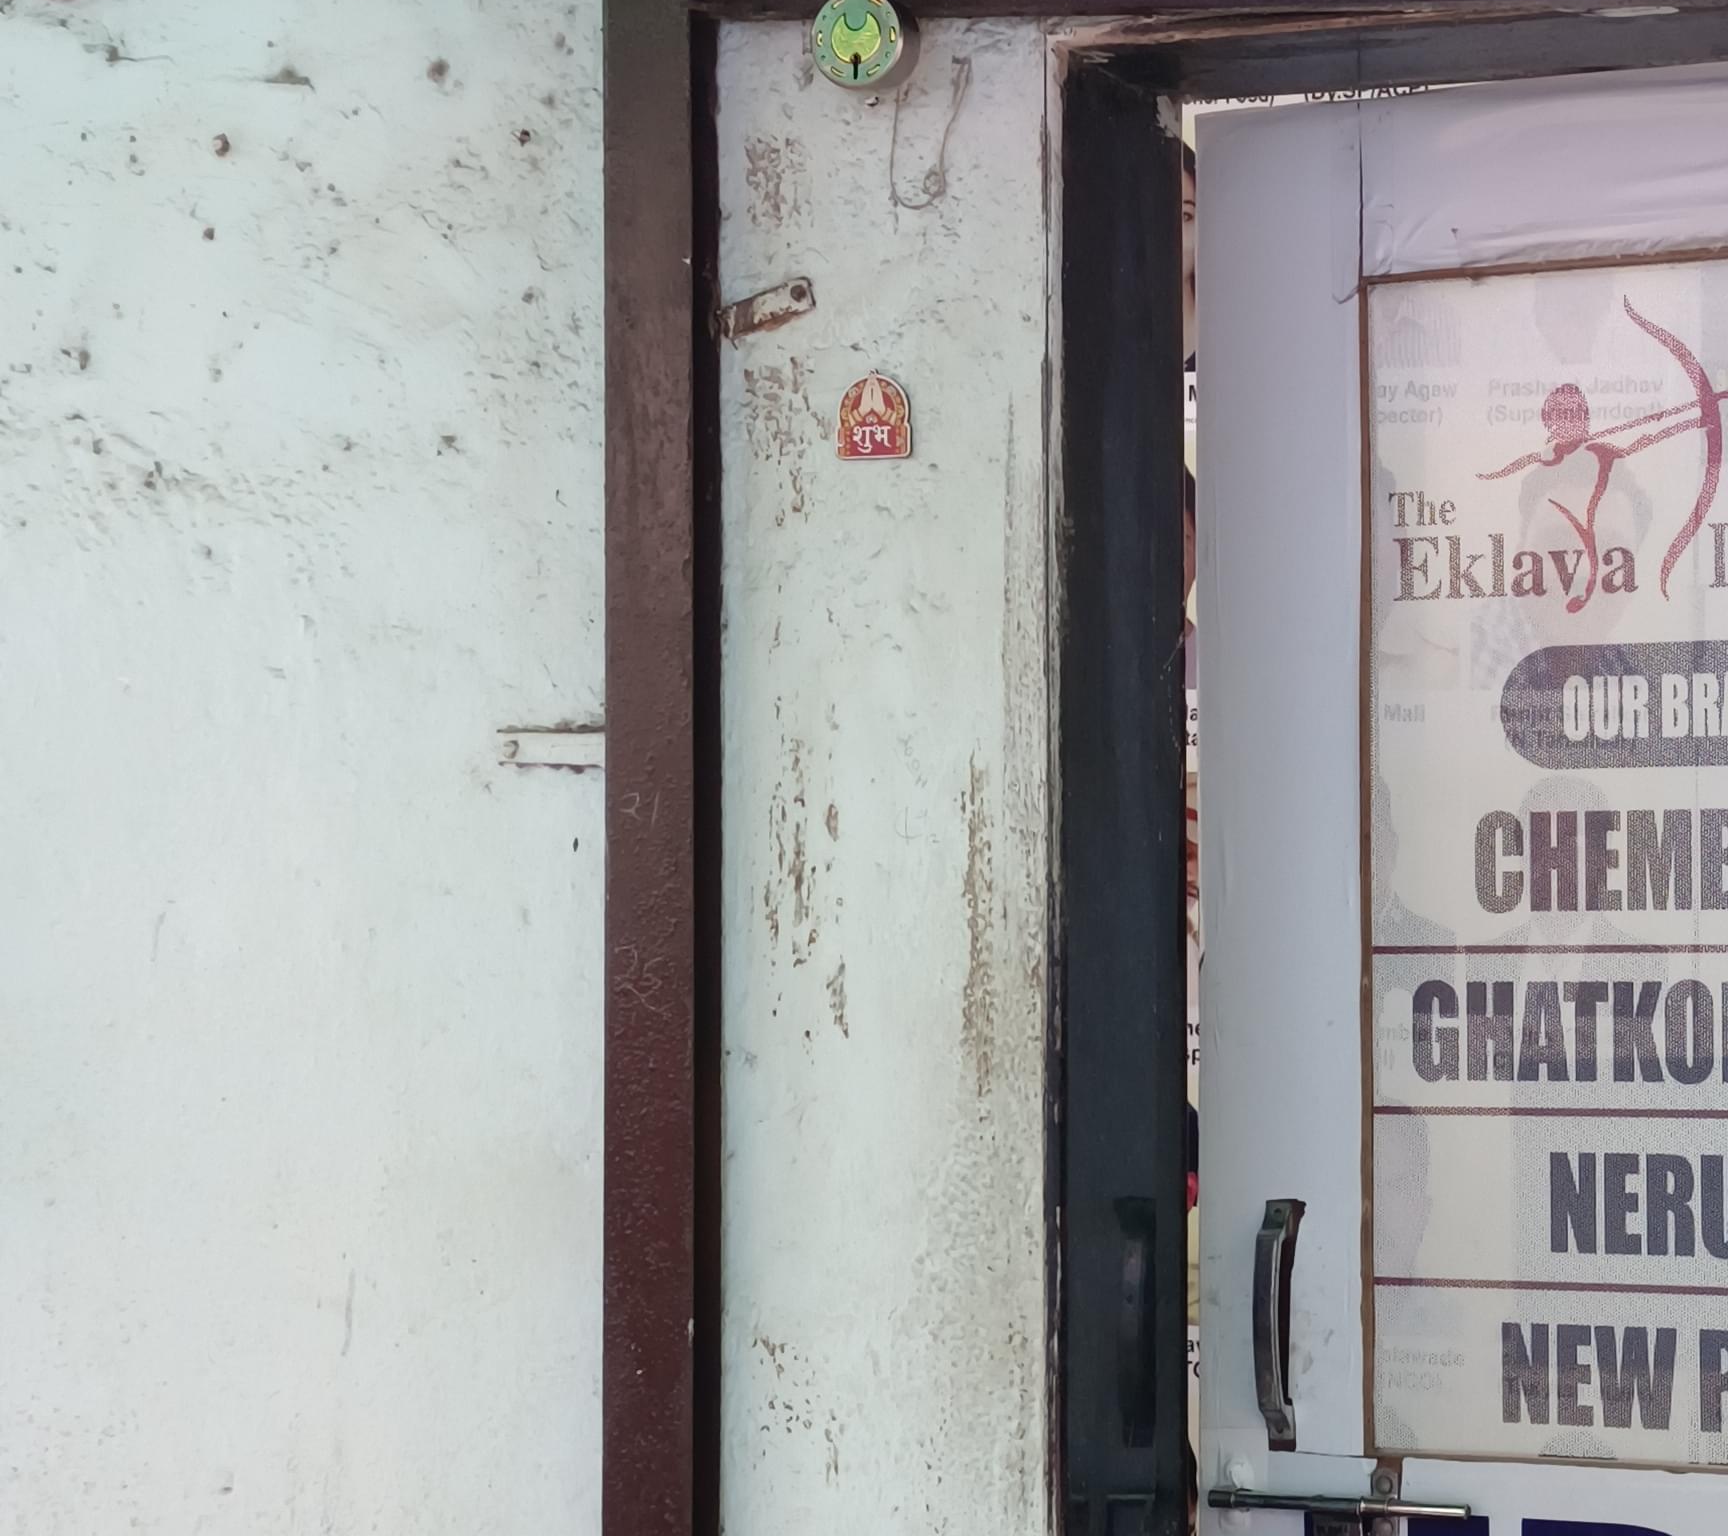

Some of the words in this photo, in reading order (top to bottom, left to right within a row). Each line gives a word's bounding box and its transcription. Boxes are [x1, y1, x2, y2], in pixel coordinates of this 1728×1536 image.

[853, 424, 892, 454] शुभ
[1388, 490, 1457, 528] The
[1392, 532, 1640, 613] Eklavya
[1561, 674, 1650, 742] OUR
[1501, 1321, 1678, 1432] NEW
